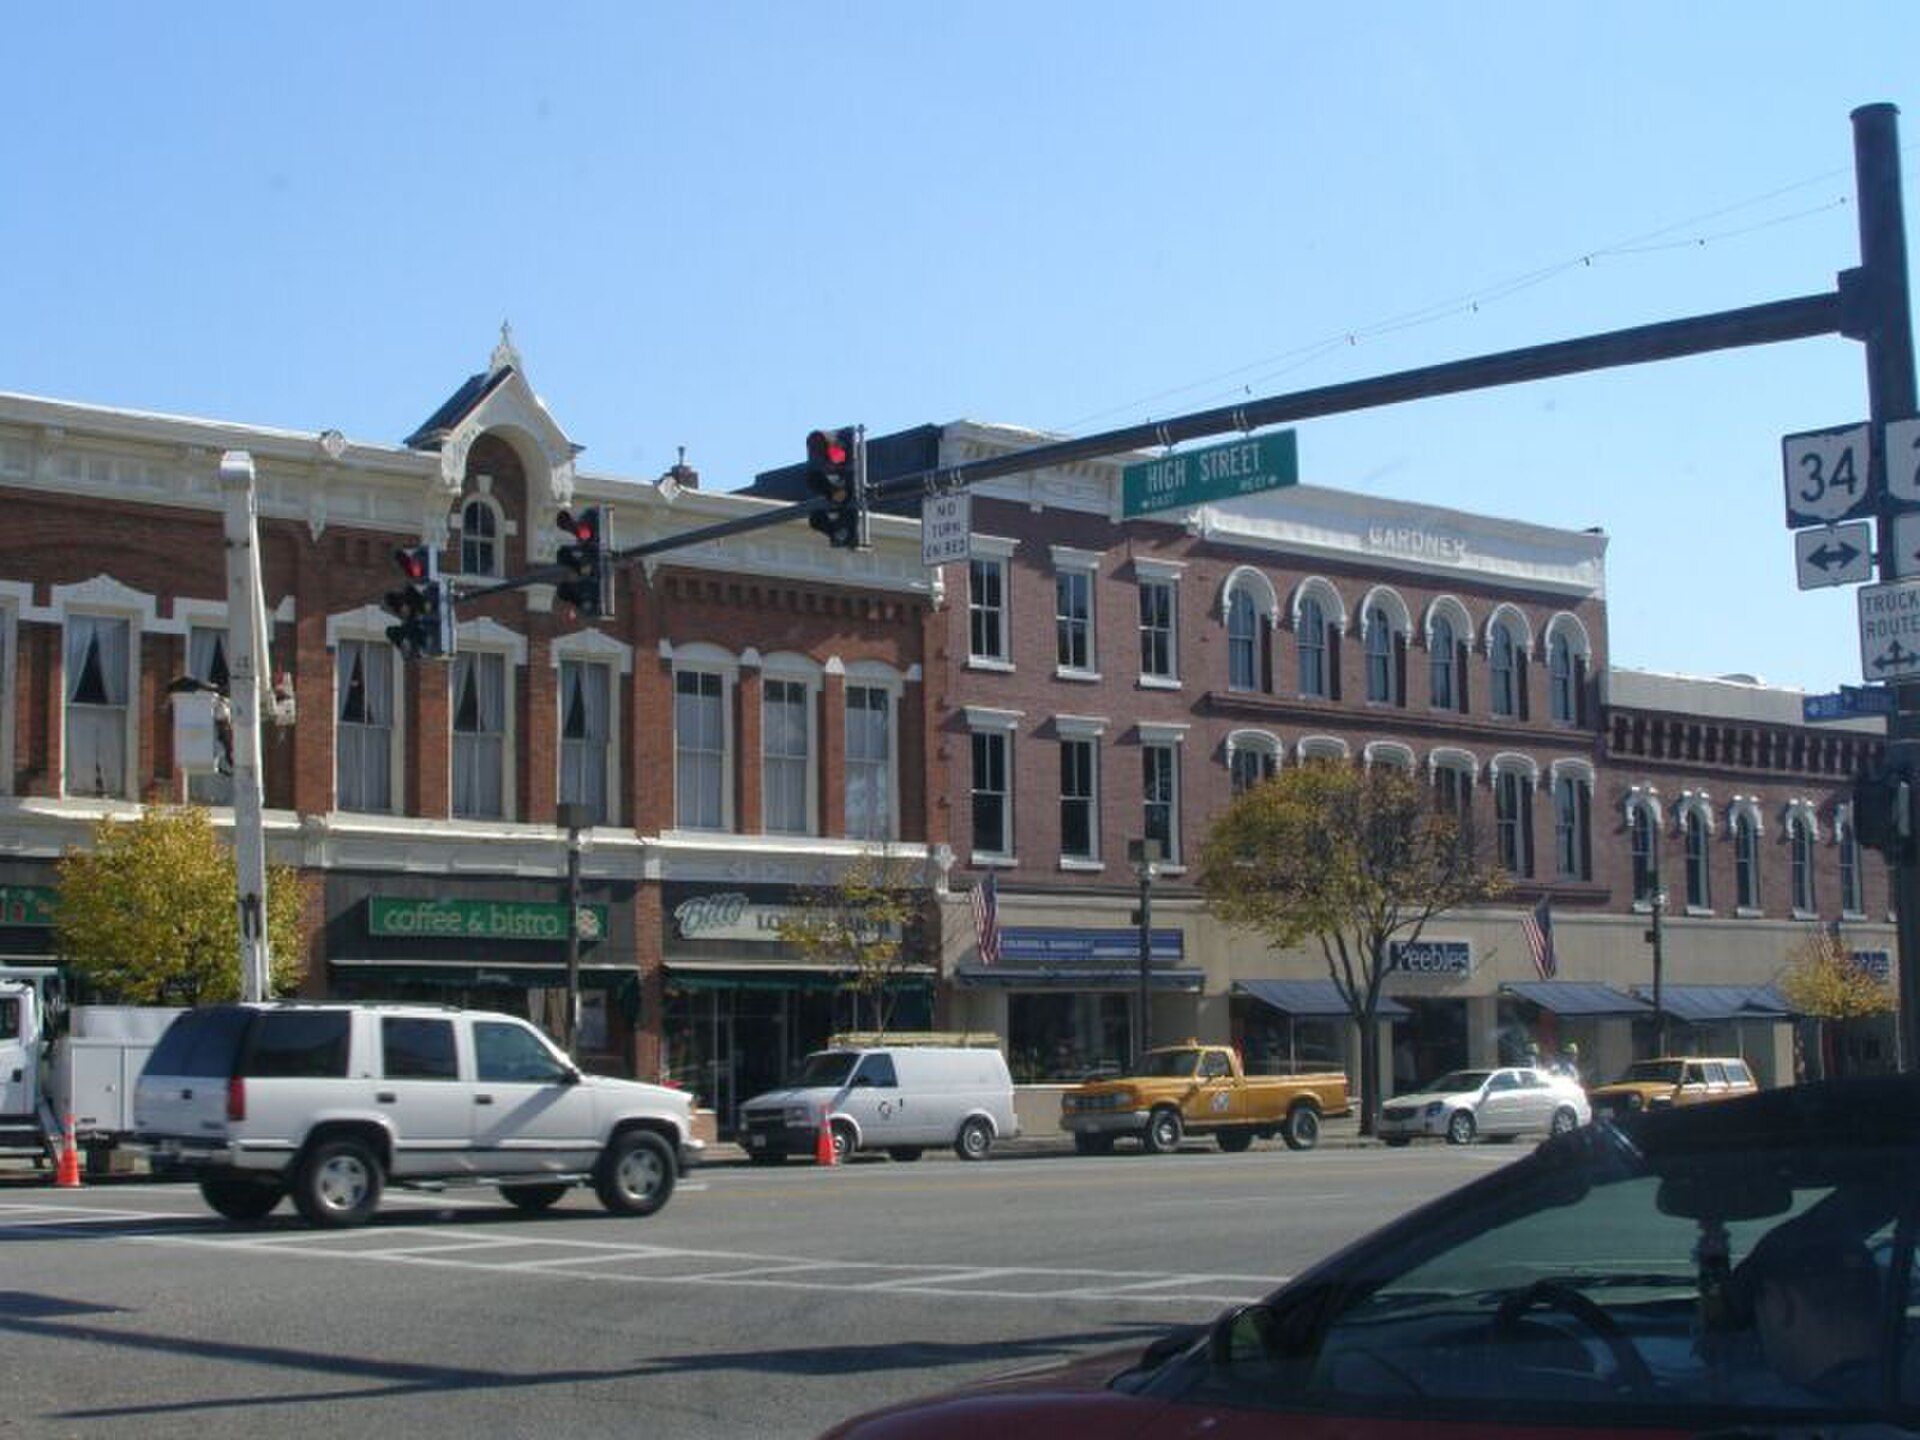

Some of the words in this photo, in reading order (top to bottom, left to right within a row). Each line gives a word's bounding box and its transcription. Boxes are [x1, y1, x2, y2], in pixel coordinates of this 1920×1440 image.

[1148, 459, 1186, 492] HIGH
[1200, 443, 1260, 481] STREET
[1800, 446, 1857, 503] 34
[937, 501, 957, 517] NO
[931, 521, 961, 538] TURN
[945, 538, 965, 555] RED
[1865, 590, 1920, 612] TRUCK
[1866, 614, 1920, 640] ROUTE
[383, 903, 461, 933] coffee
[467, 912, 485, 932] &
[491, 904, 559, 936] bistro
